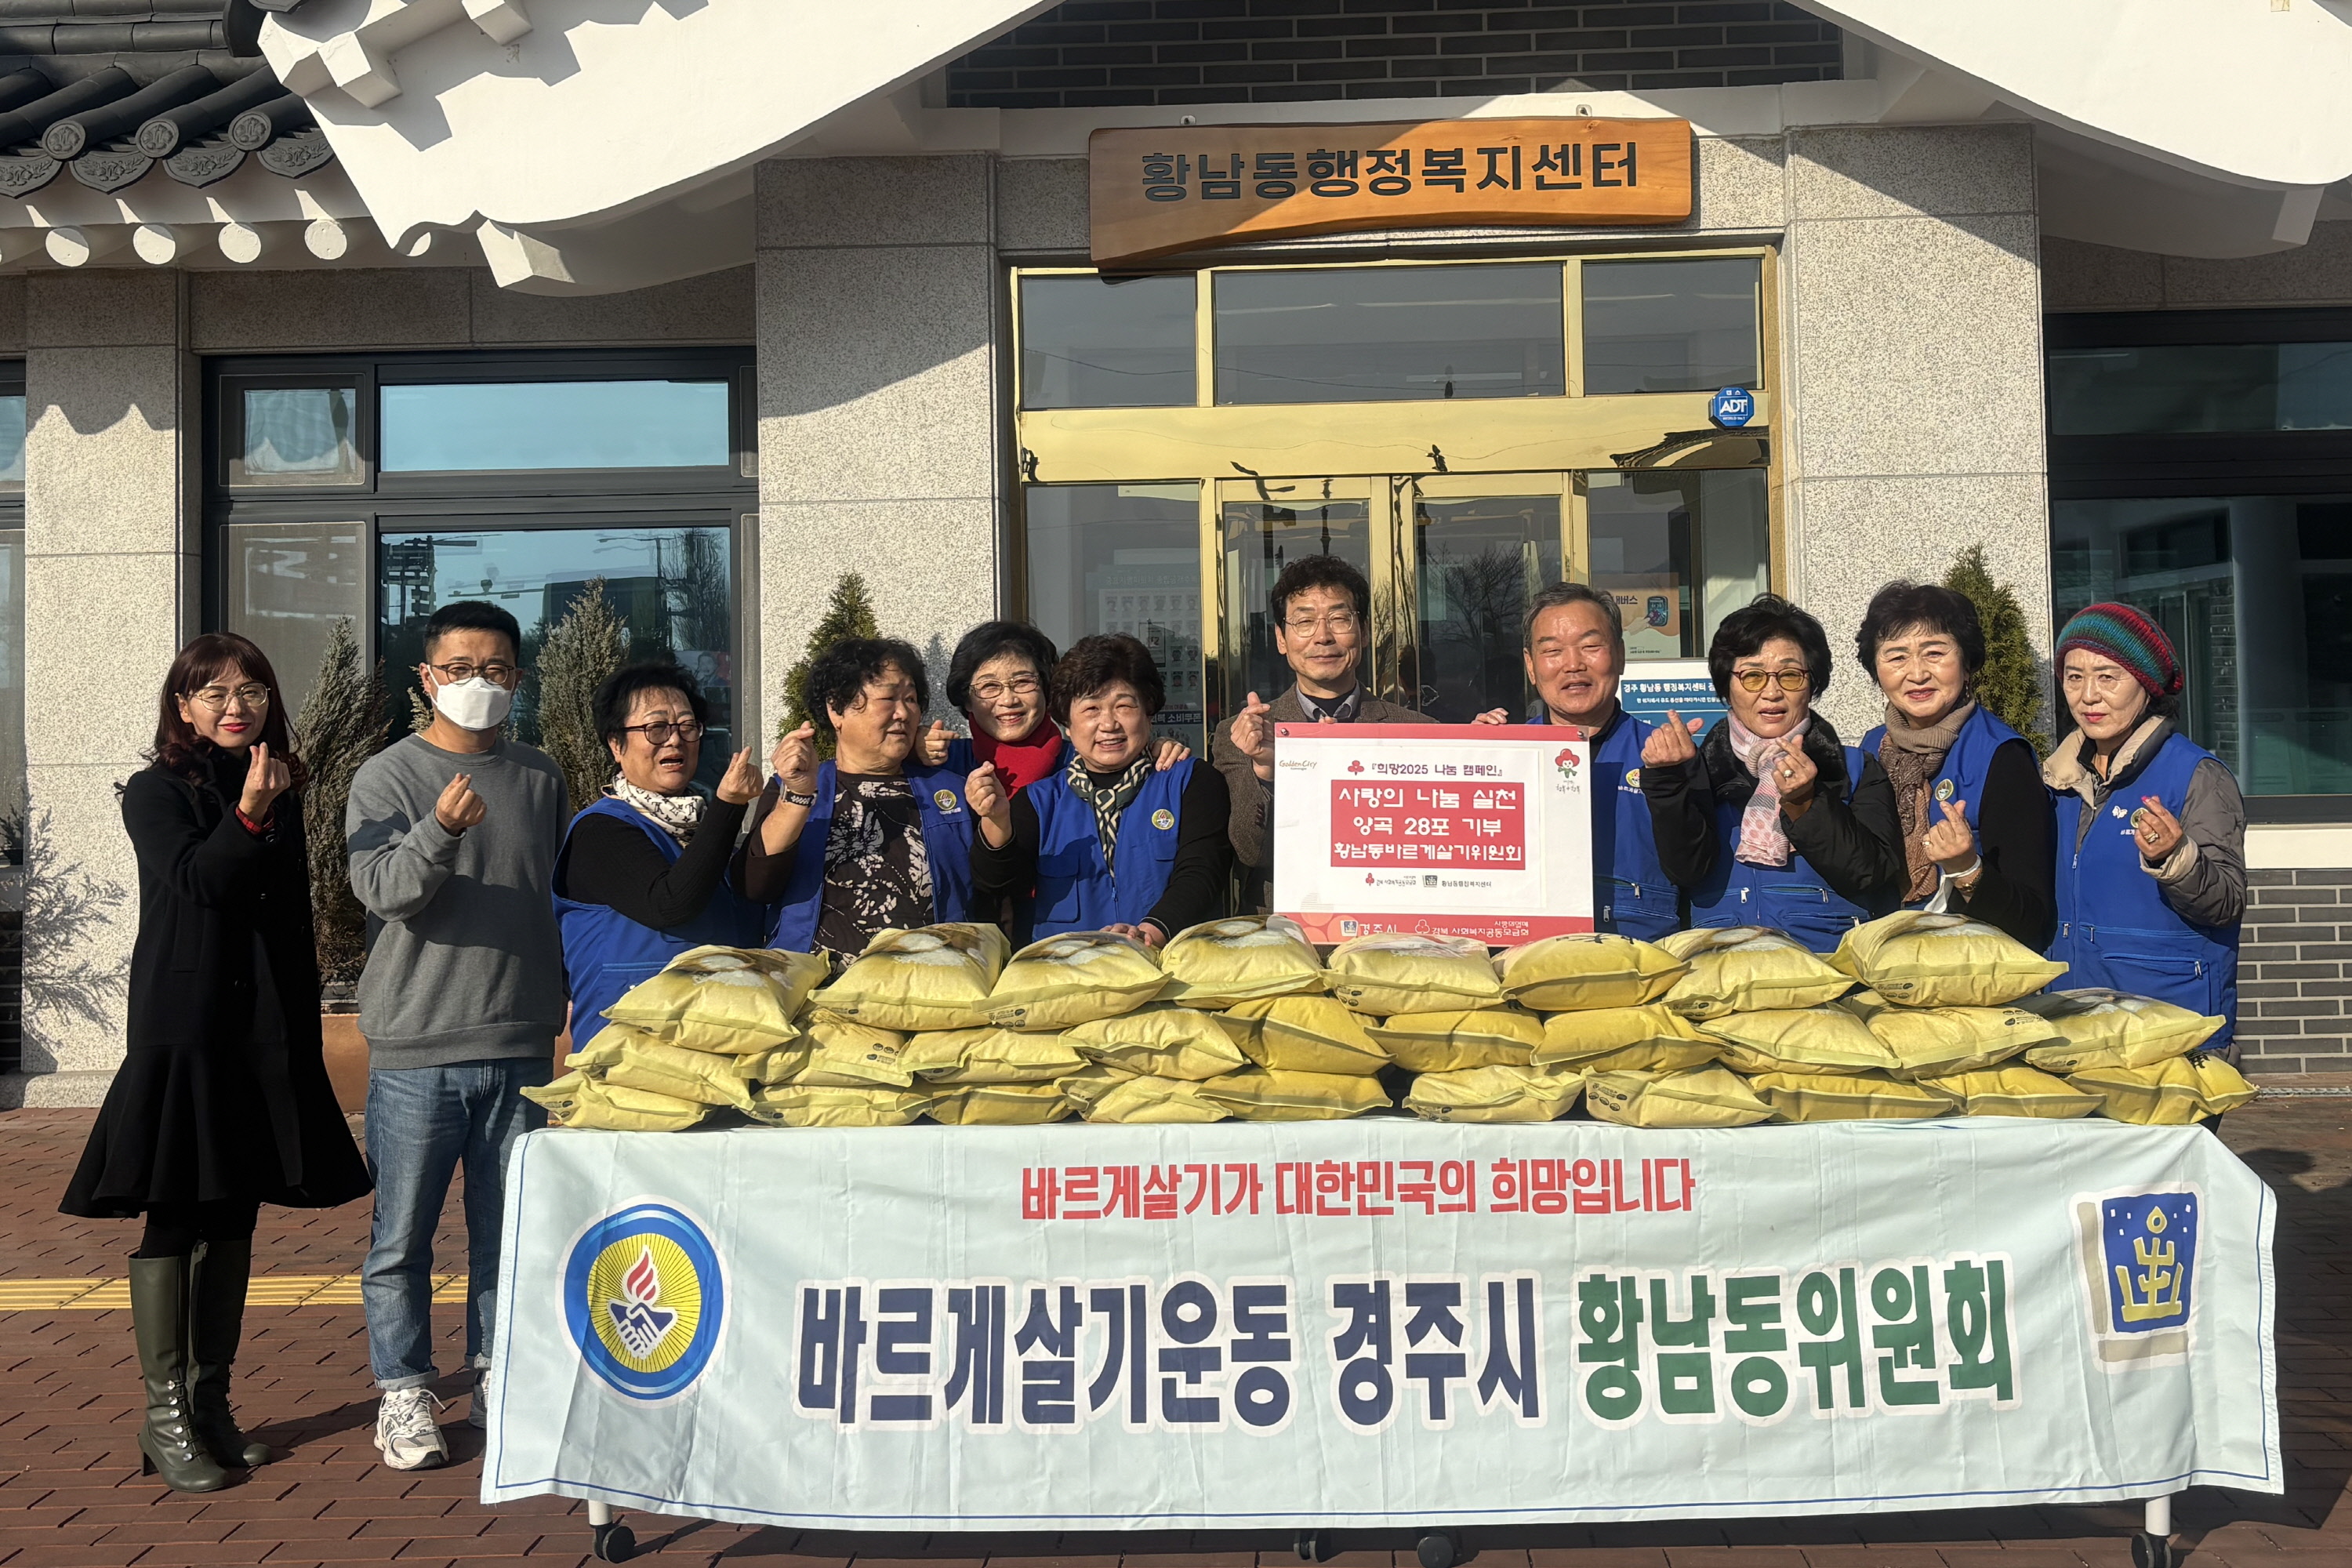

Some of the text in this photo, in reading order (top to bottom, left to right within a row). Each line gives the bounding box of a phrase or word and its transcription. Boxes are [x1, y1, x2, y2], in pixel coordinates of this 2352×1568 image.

[1142, 141, 1638, 201] 황남동행정복지센터
[1720, 399, 1748, 414] ADT
[1639, 683, 1661, 693] 황남동
[1663, 683, 1706, 692] 행정복지센터
[1435, 764, 1457, 776] 나눔
[1338, 786, 1517, 810] 사랑의 나눔 실천
[1353, 817, 1502, 837] 양곡 28포 기부
[1334, 841, 1522, 862] 황남동바르게살기위원회
[1359, 924, 1397, 934] 경주시
[1452, 928, 1530, 938] 사회복지공동모금회
[1022, 1158, 1696, 1220] 바르게살기가 대한민국의 희망입니다
[800, 1259, 2015, 1427] 바르게살기운동 경주시 황남동위원회
